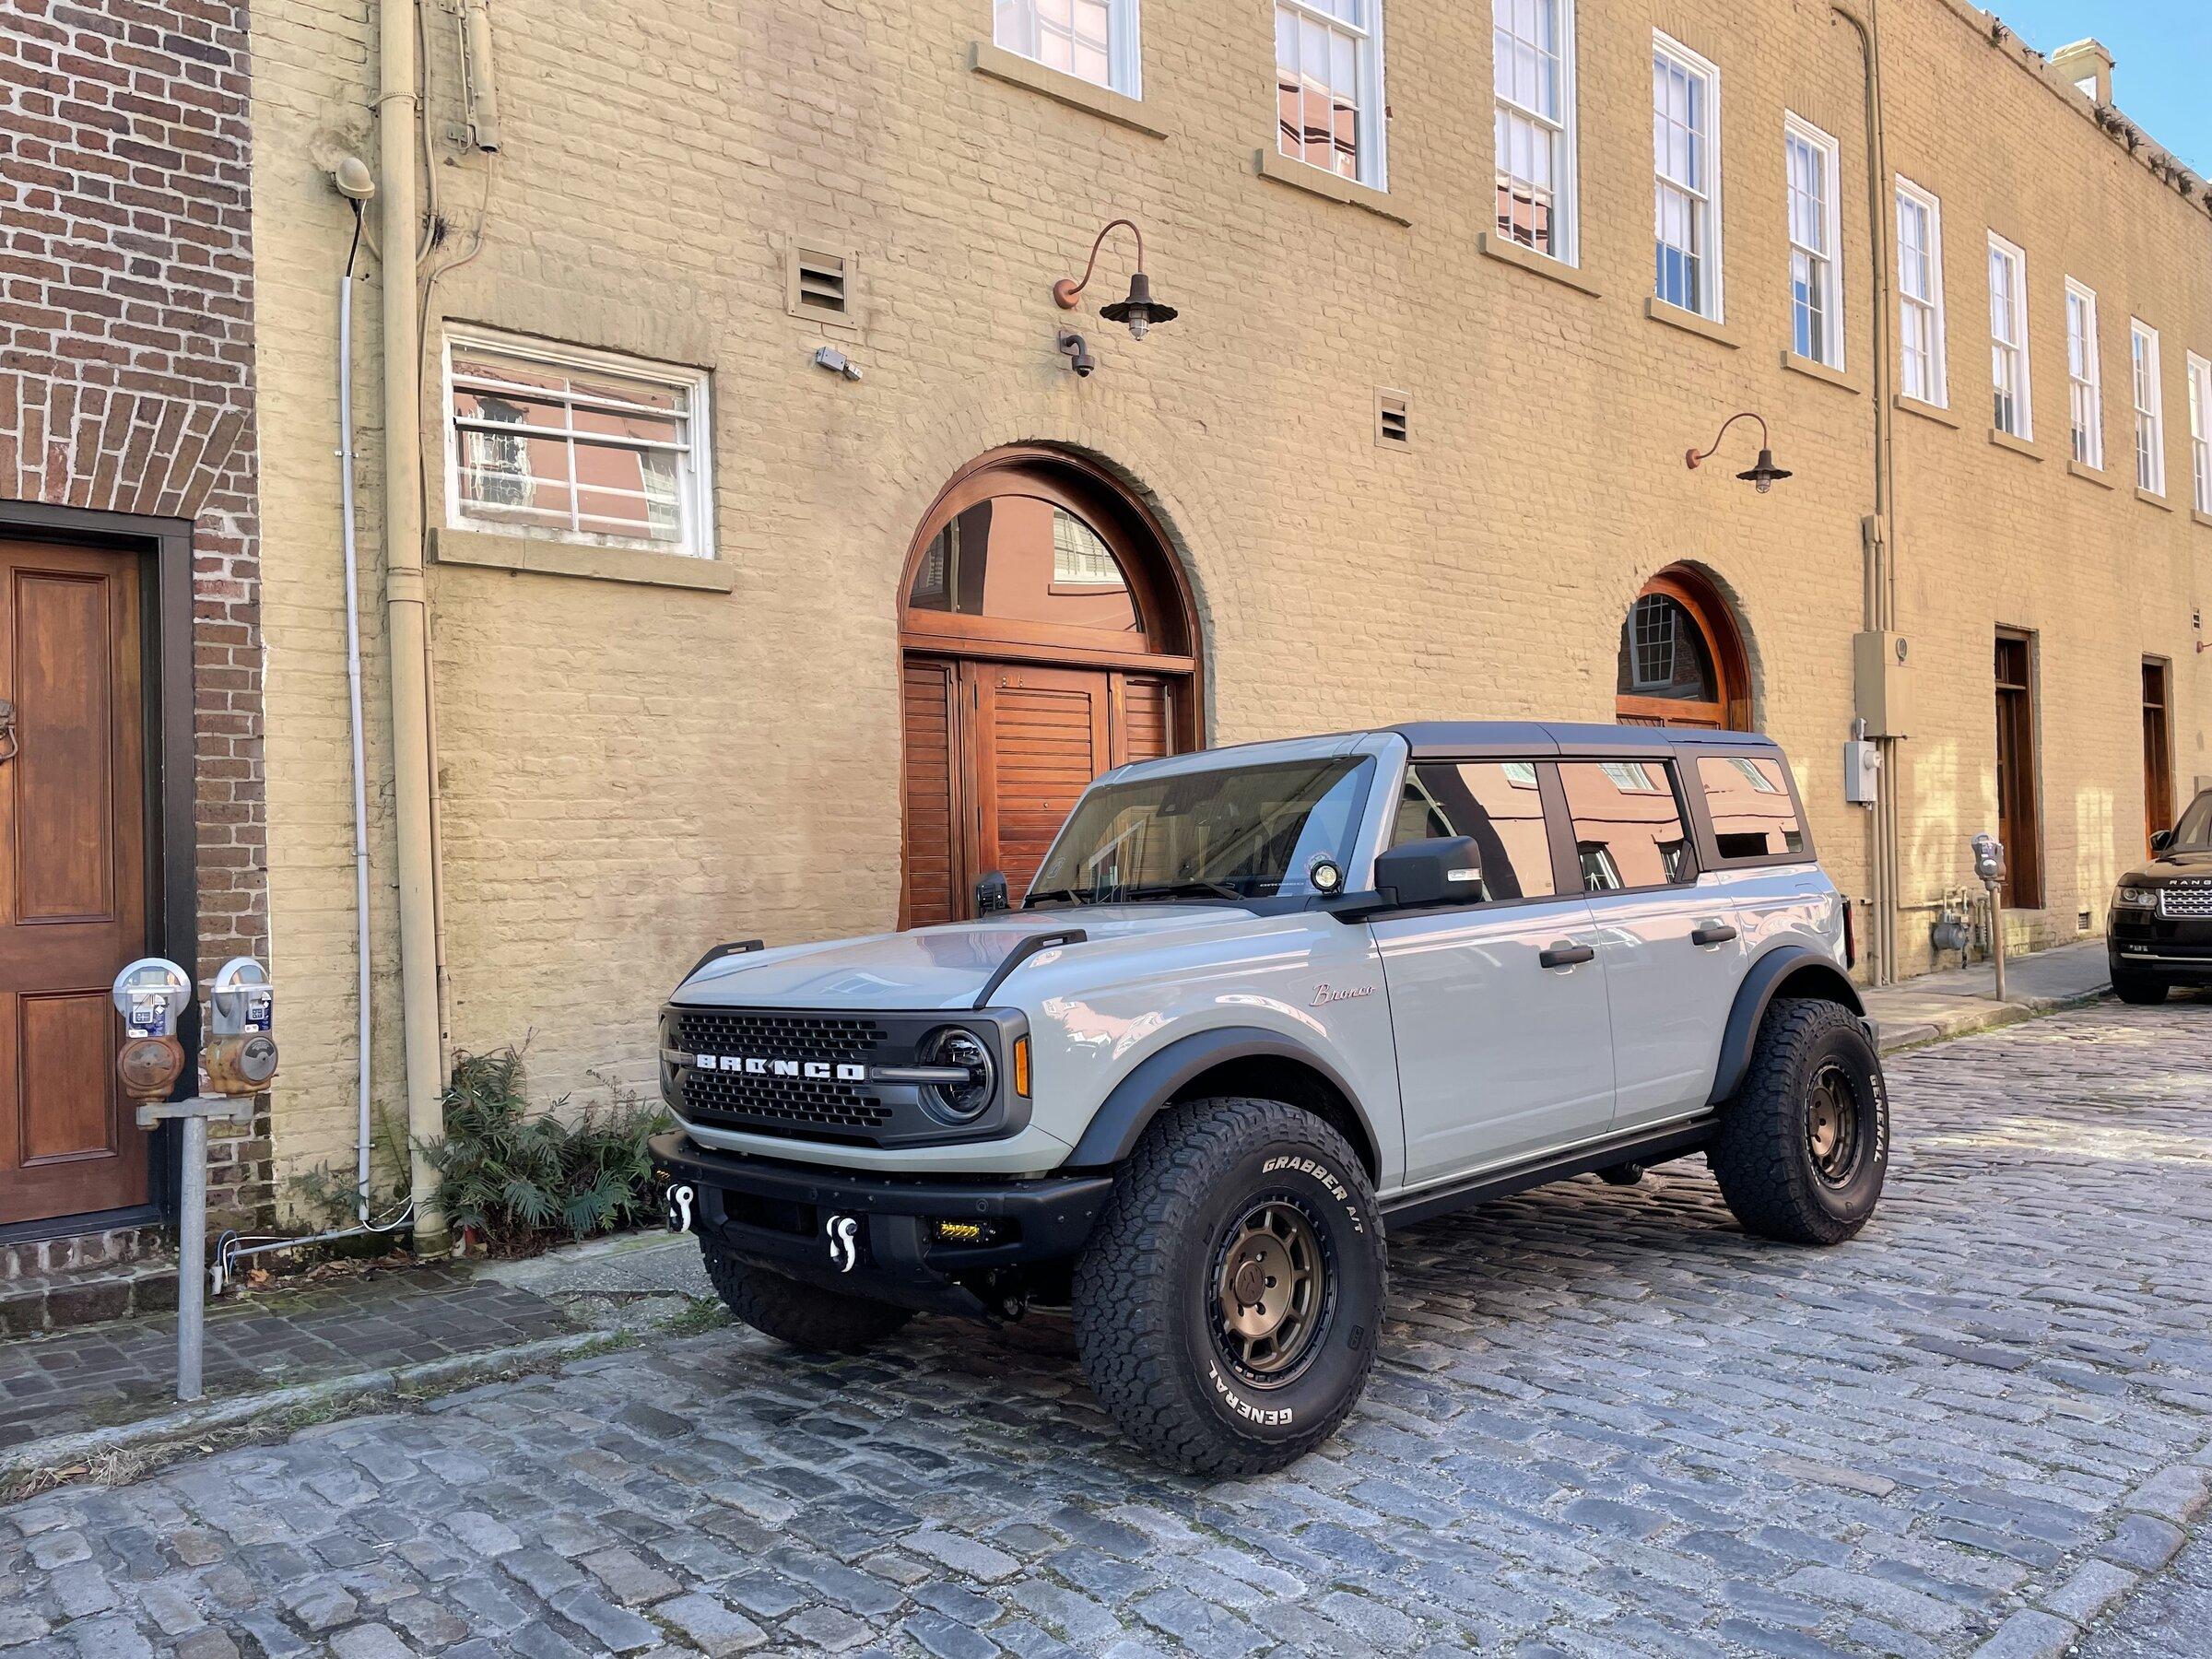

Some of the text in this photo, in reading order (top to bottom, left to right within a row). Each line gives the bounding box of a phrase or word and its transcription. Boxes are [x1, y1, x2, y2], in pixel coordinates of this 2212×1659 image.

[1308, 982, 1377, 1007] Bronco
[697, 1053, 865, 1081] BRONCO
[1869, 1074, 1885, 1162] GENERAL
[1262, 1155, 1363, 1234] GRABBER A/T
[1208, 1359, 1293, 1426] GENERAL
